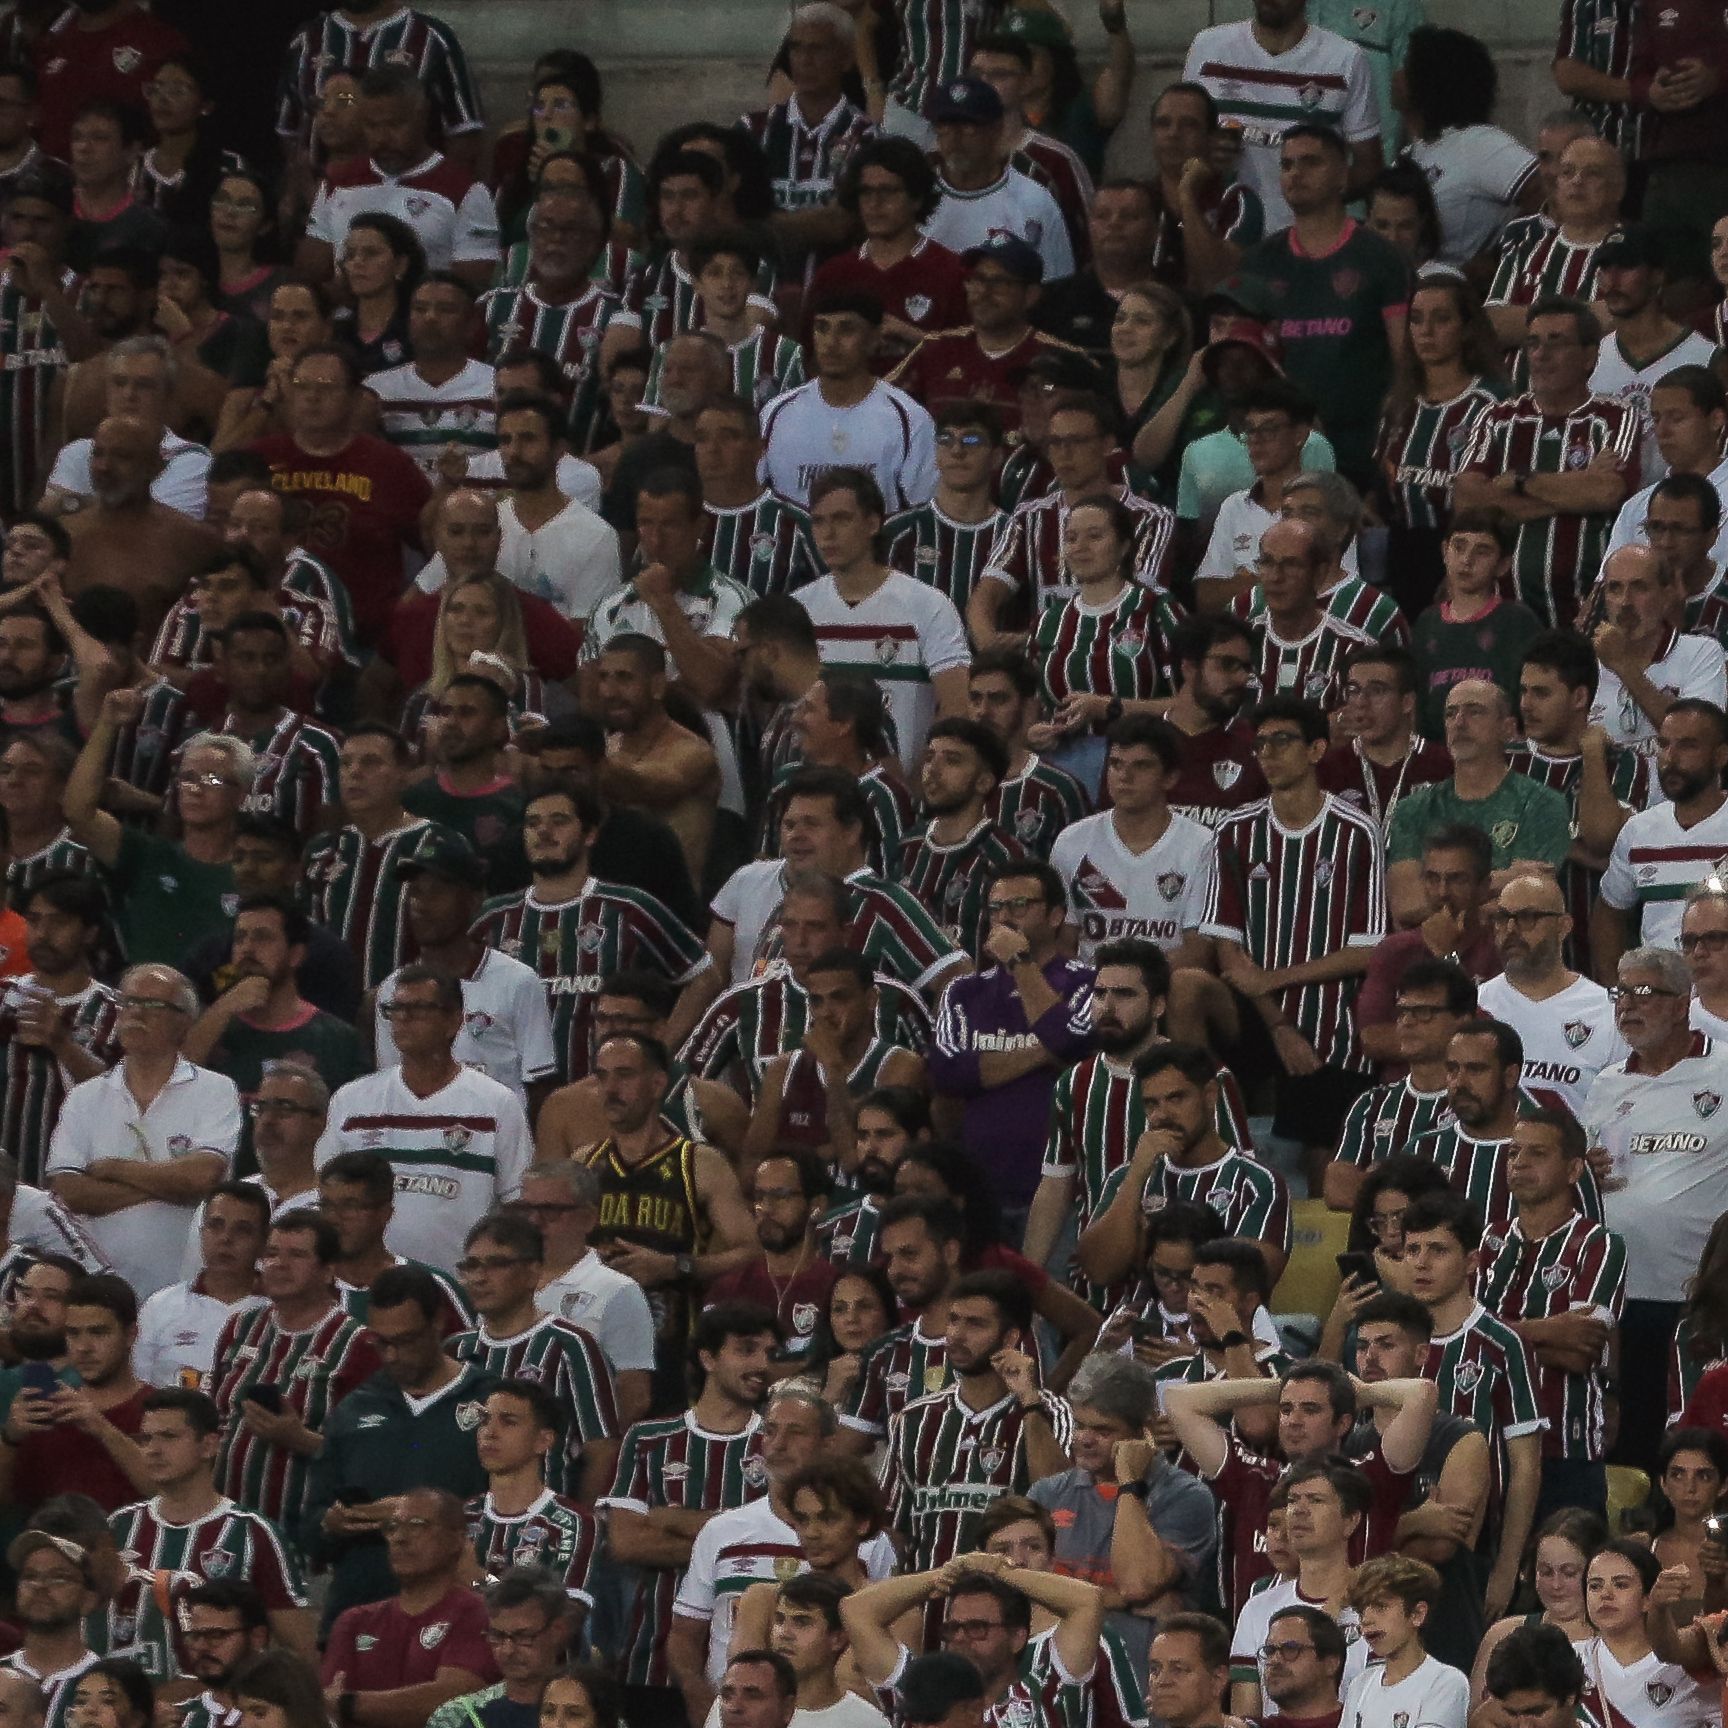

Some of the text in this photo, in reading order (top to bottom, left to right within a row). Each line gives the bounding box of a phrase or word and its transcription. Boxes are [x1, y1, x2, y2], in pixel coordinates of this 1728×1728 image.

[1280, 317, 1353, 338] BETANO
[1109, 916, 1178, 939] BTANO
[545, 975, 602, 995] TANO
[1524, 1060, 1581, 1085] TANO
[394, 1175, 461, 1200] ETANO
